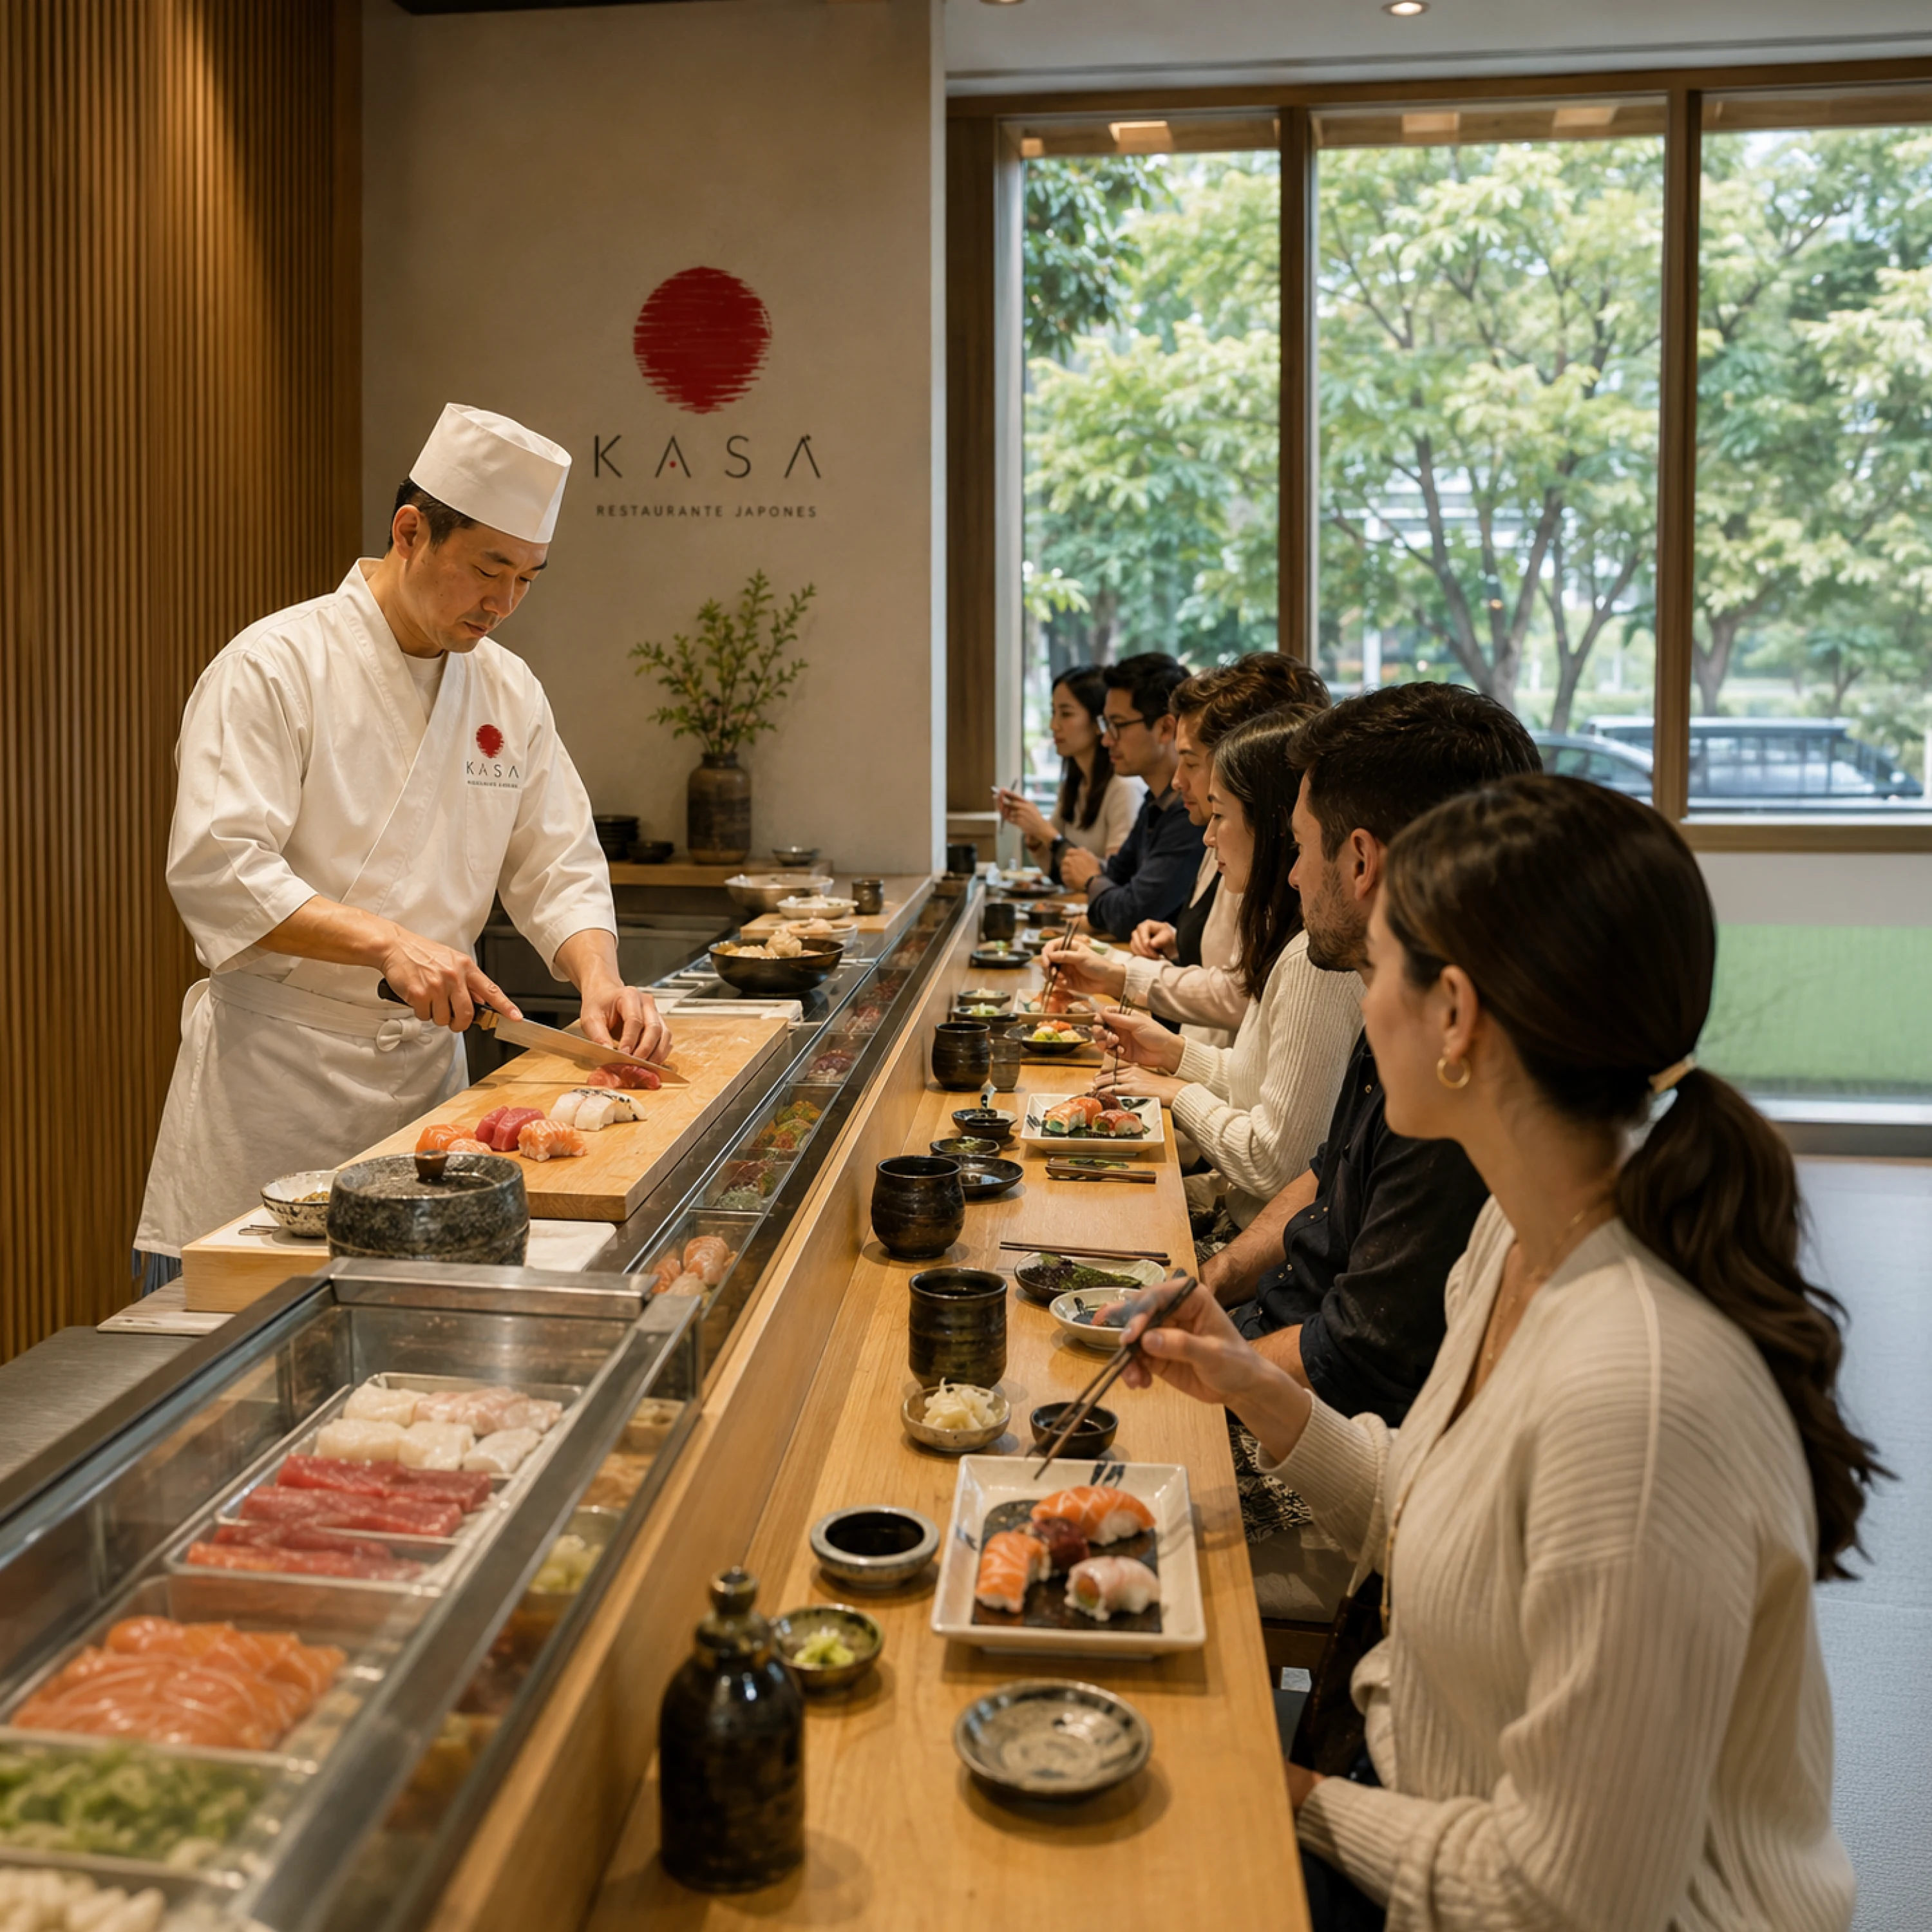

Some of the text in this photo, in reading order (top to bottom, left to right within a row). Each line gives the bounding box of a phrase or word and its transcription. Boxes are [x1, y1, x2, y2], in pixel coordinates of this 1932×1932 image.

[594, 435, 820, 478] KASA
[596, 505, 816, 518] RESTAURANTE JAPONES
[466, 761, 519, 778] KASA
